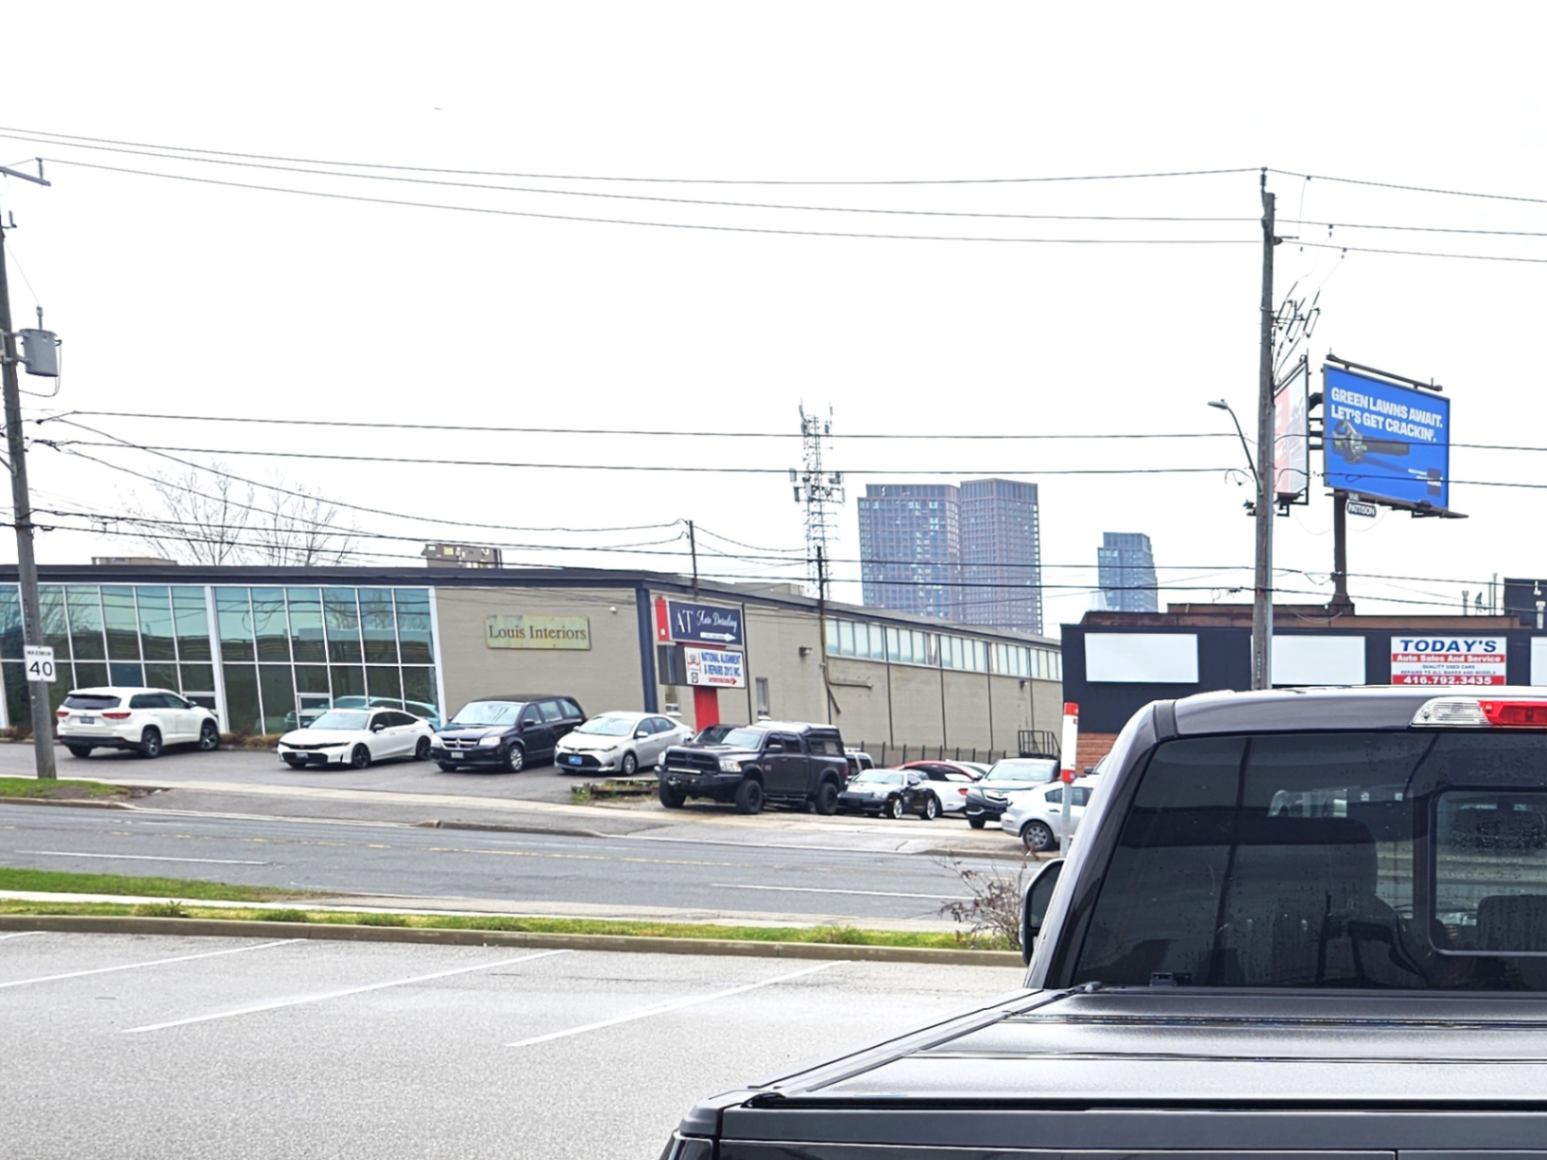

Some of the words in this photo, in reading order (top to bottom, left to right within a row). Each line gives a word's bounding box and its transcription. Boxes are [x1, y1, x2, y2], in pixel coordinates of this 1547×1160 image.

[1331, 387, 1368, 409] GREEN
[1369, 397, 1408, 420] LAWNS
[1409, 408, 1443, 428] AWAIT.
[1331, 405, 1361, 424] LET'S
[1363, 412, 1384, 429] GET
[1348, 503, 1376, 516] PATTISON
[488, 625, 525, 639] Louis
[529, 625, 587, 640] Interiors
[1400, 640, 1497, 653] TODAY'S
[1396, 654, 1418, 663] Auto
[1420, 654, 1445, 663] Sales
[1446, 654, 1465, 663] And
[1467, 654, 1501, 664] Service
[29, 661, 53, 677] 40
[1403, 676, 1492, 685] 416.792.3435
